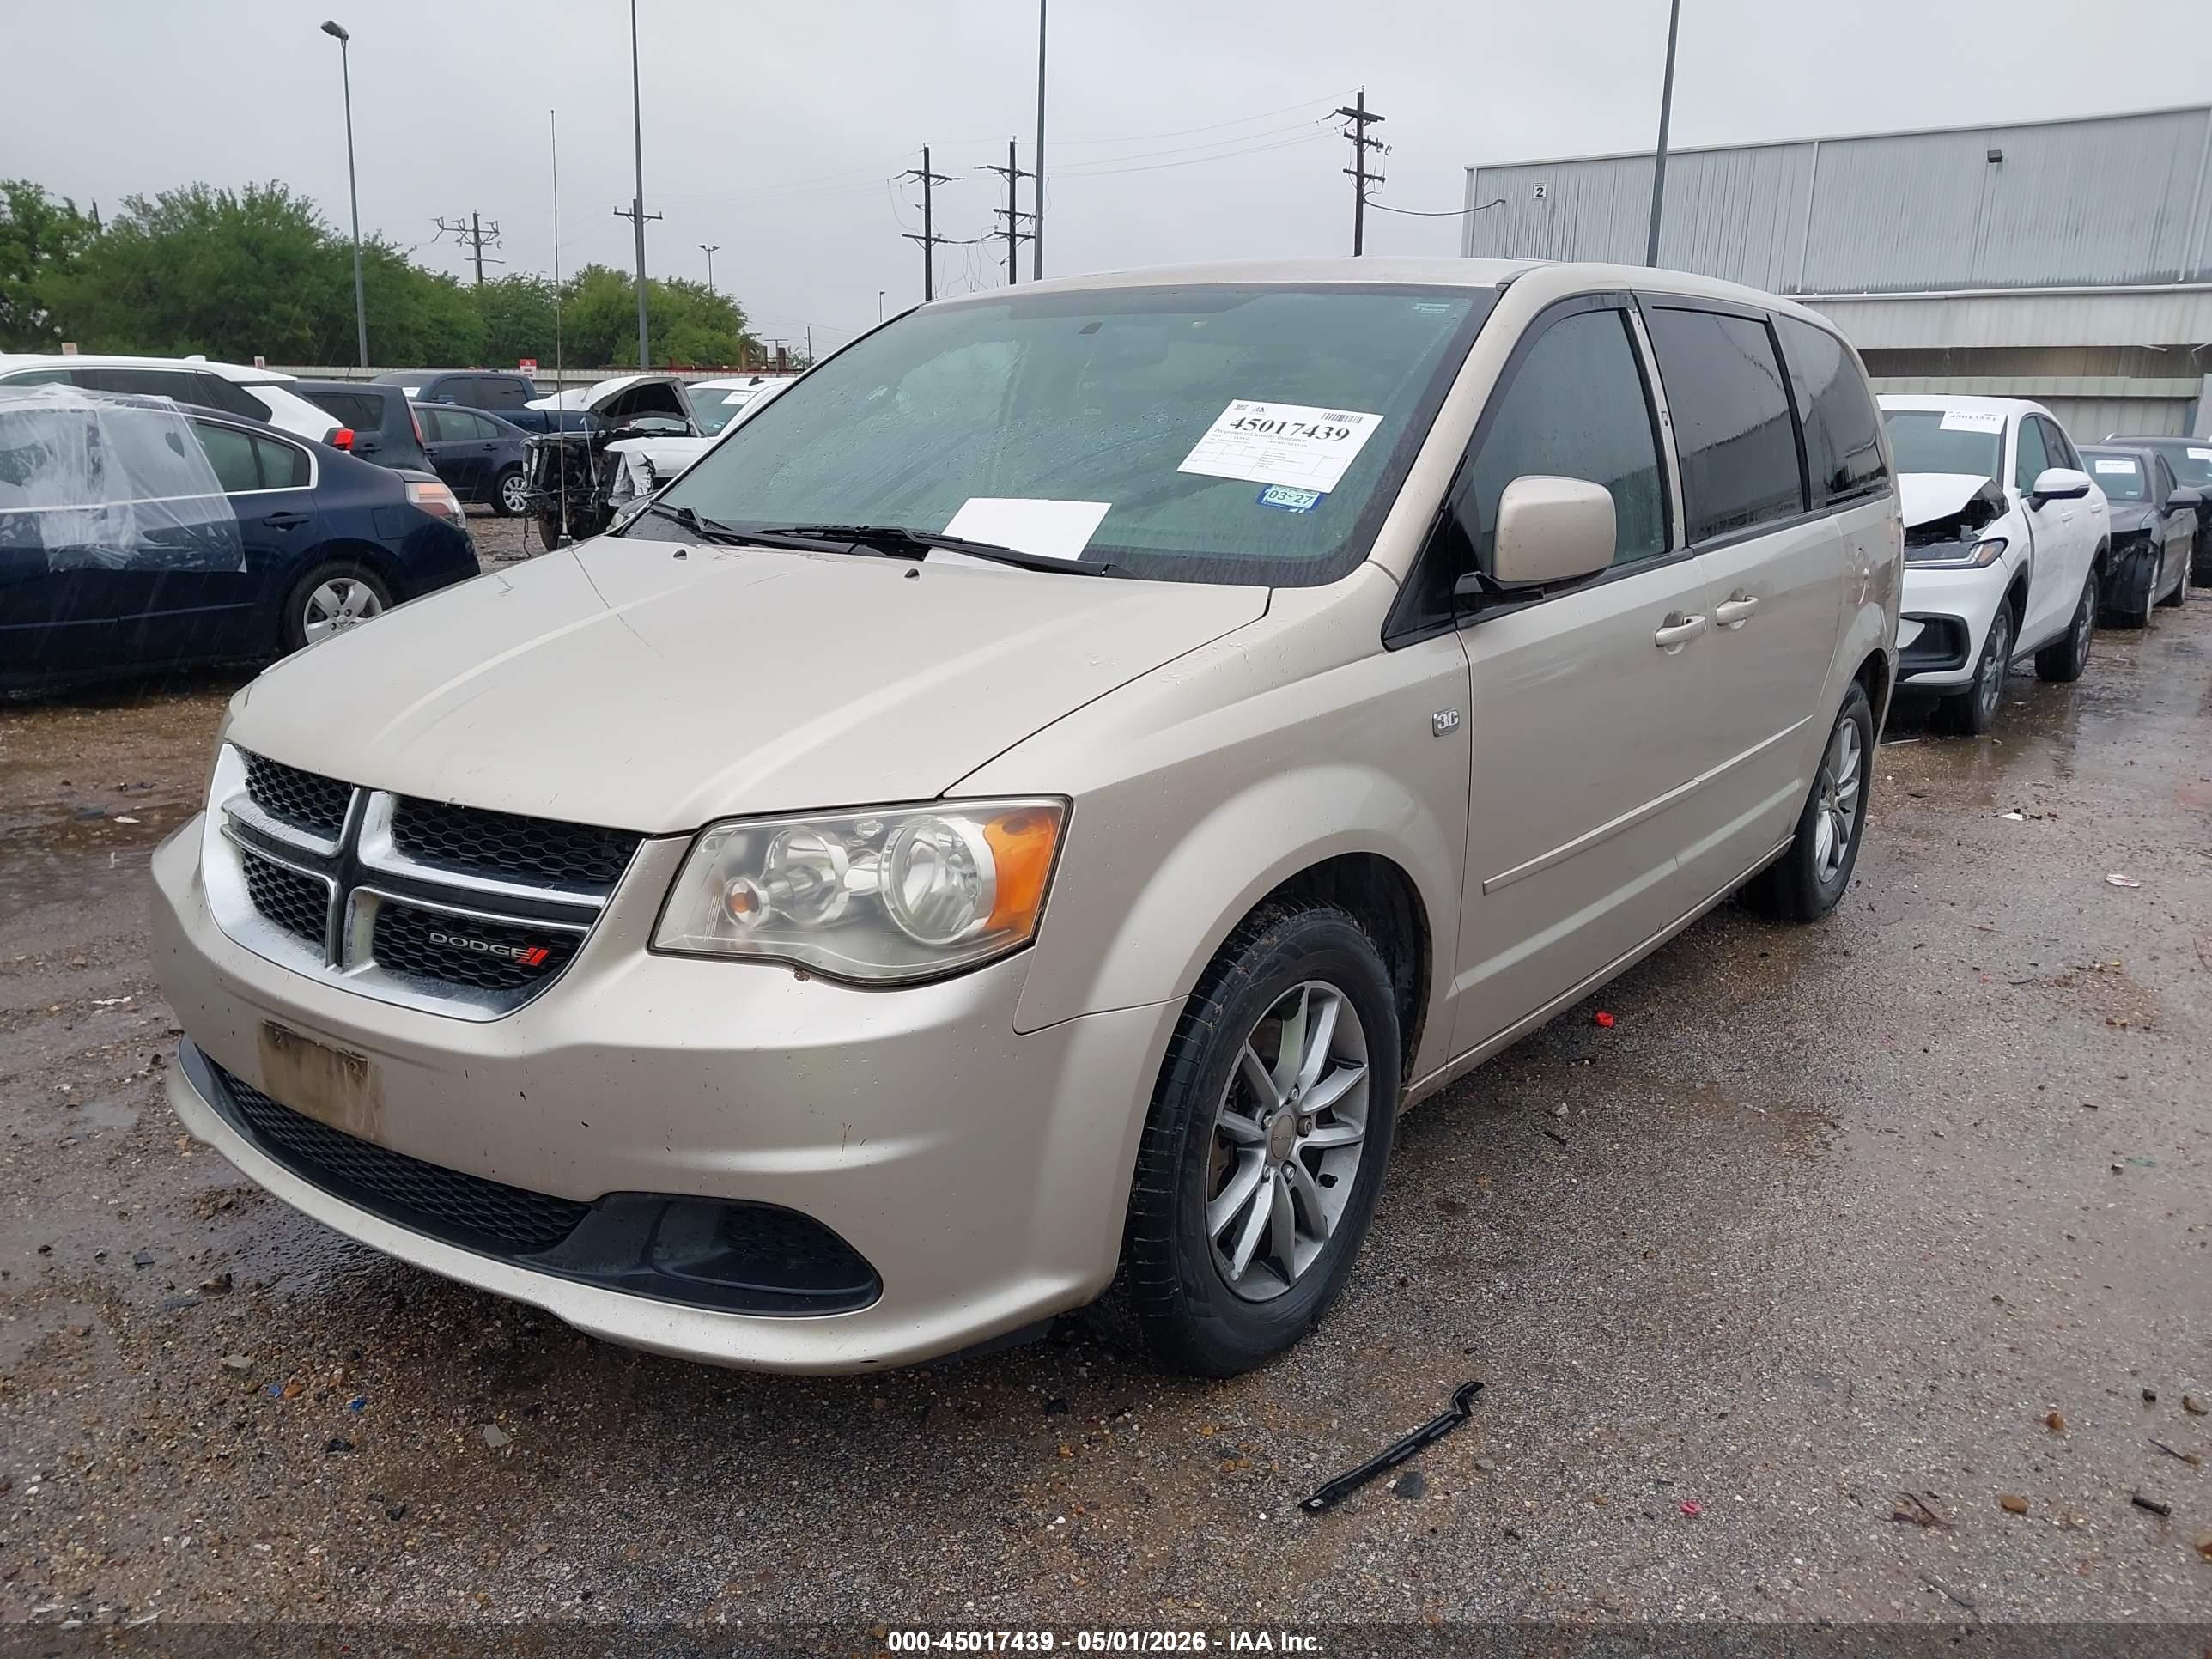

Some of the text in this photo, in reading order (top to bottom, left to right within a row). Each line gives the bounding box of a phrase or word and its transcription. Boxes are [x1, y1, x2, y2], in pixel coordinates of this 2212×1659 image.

[1535, 187, 1544, 198] 2
[1229, 416, 1351, 441] 45017439
[1268, 490, 1288, 501] 03
[1292, 494, 1315, 505] 27
[429, 932, 531, 960] DODGE
